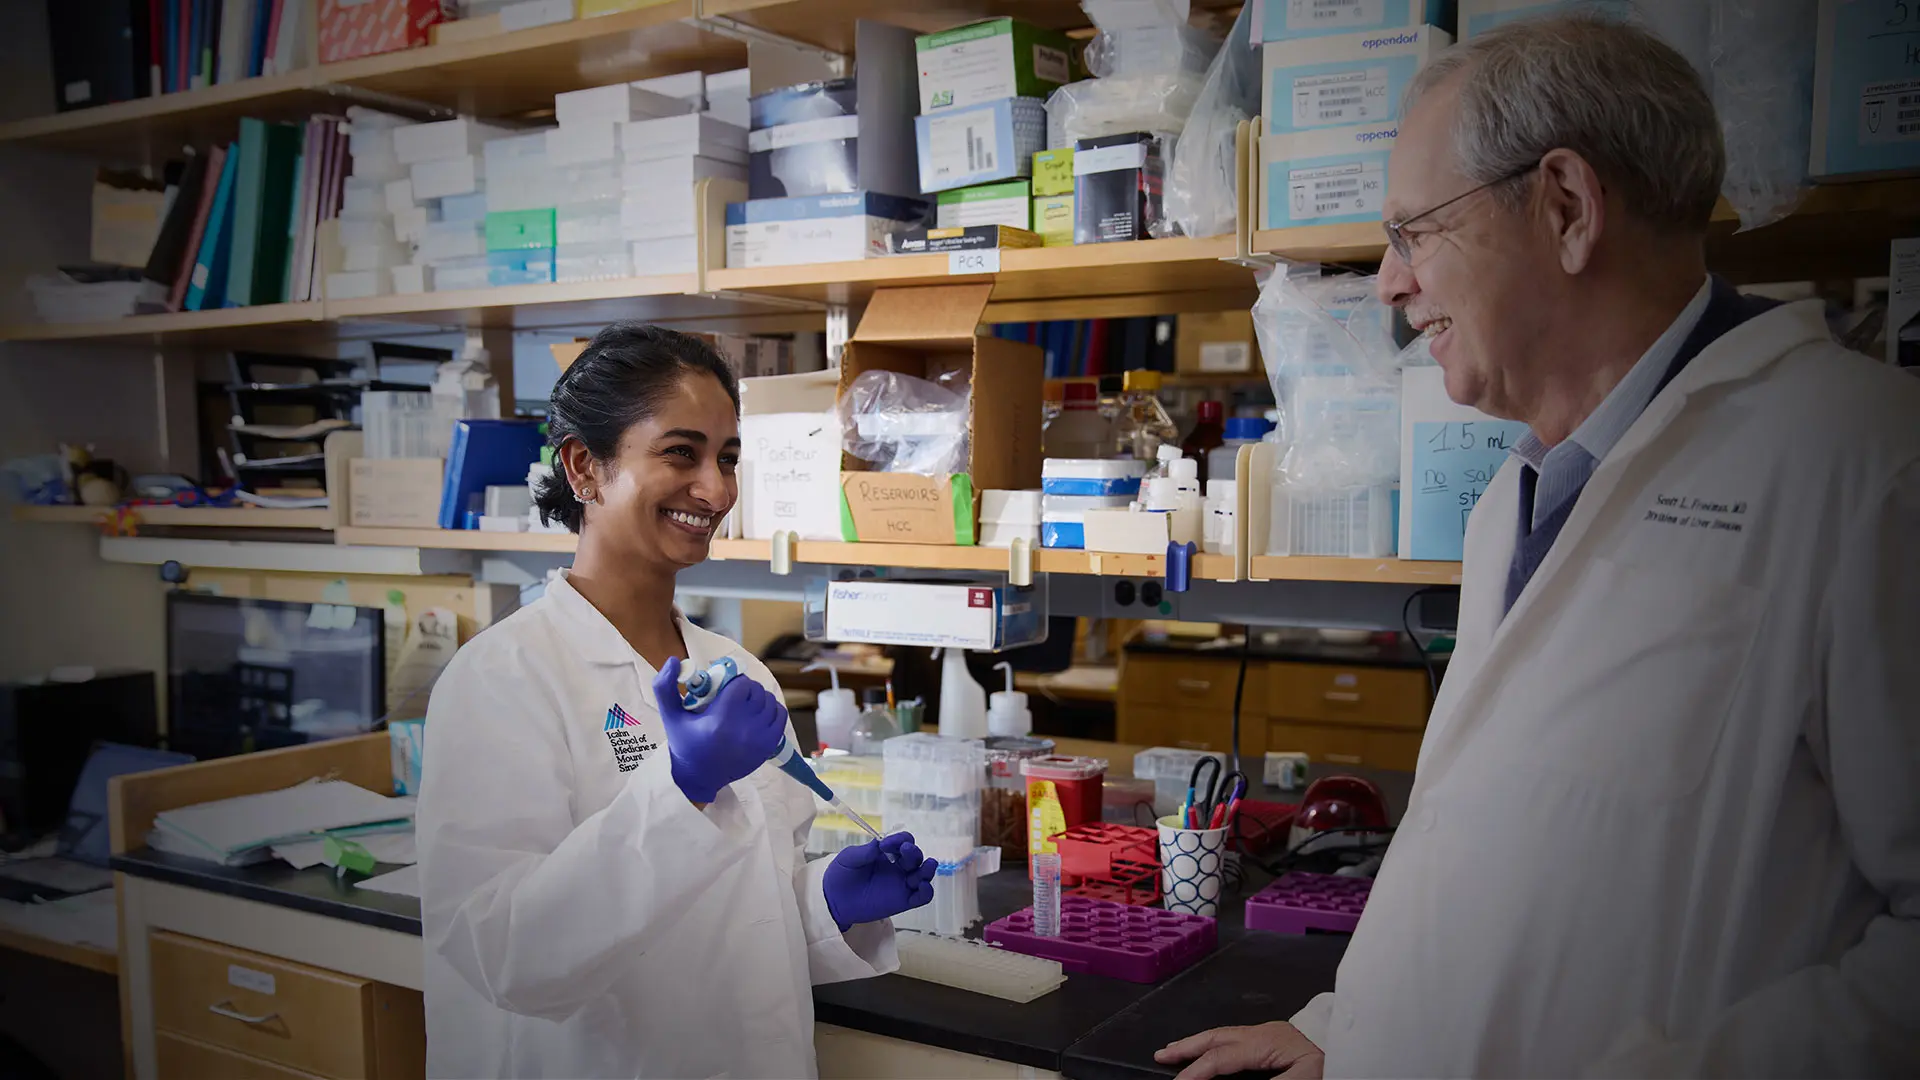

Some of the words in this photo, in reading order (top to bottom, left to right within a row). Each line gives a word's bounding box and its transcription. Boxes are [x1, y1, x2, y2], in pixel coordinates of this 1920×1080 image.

[1362, 32, 1419, 49] eppendorf
[1356, 127, 1398, 142] eppend
[958, 256, 984, 268] PCR
[1428, 422, 1476, 453] 1.5
[1487, 431, 1510, 449] mL
[1424, 469, 1447, 485] no
[859, 480, 940, 502] RESERVOIRS
[887, 520, 912, 532] HCC
[606, 729, 630, 739] Icahn
[610, 736, 638, 747] School
[638, 734, 647, 743] of
[613, 744, 650, 756] Medicine
[616, 753, 644, 764] Mount
